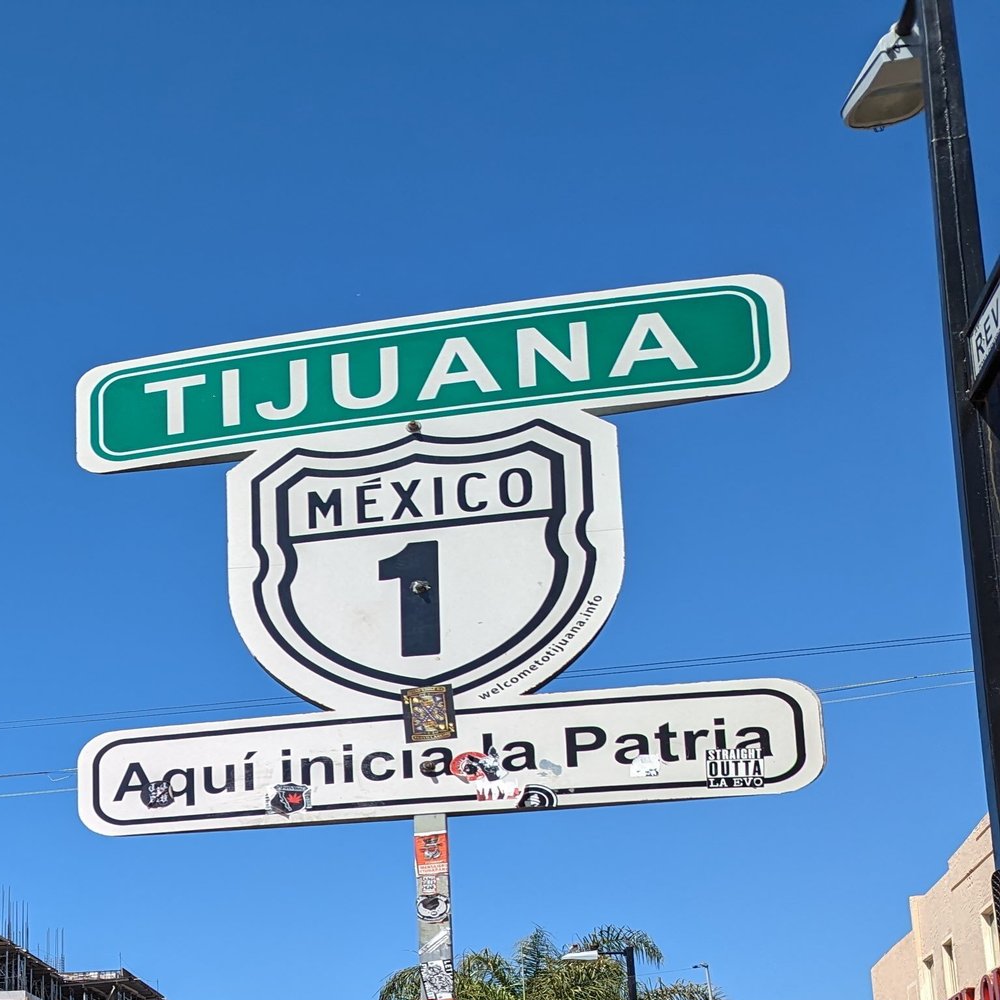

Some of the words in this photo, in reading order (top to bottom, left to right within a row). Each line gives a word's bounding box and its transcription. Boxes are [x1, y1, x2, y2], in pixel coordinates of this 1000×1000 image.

[144, 312, 697, 436] TIJUANA
[307, 467, 533, 530] MÉXICO
[378, 540, 441, 657] 1
[478, 595, 603, 700] welcometotijuana.info
[112, 750, 258, 807] Aquí
[281, 744, 453, 786] inicia
[482, 732, 539, 772] la
[564, 717, 774, 768] Patria
[708, 748, 762, 761] STRAIGHT
[709, 760, 762, 777] OUTTA
[709, 778, 728, 788] LA
[733, 777, 763, 788] EVO
